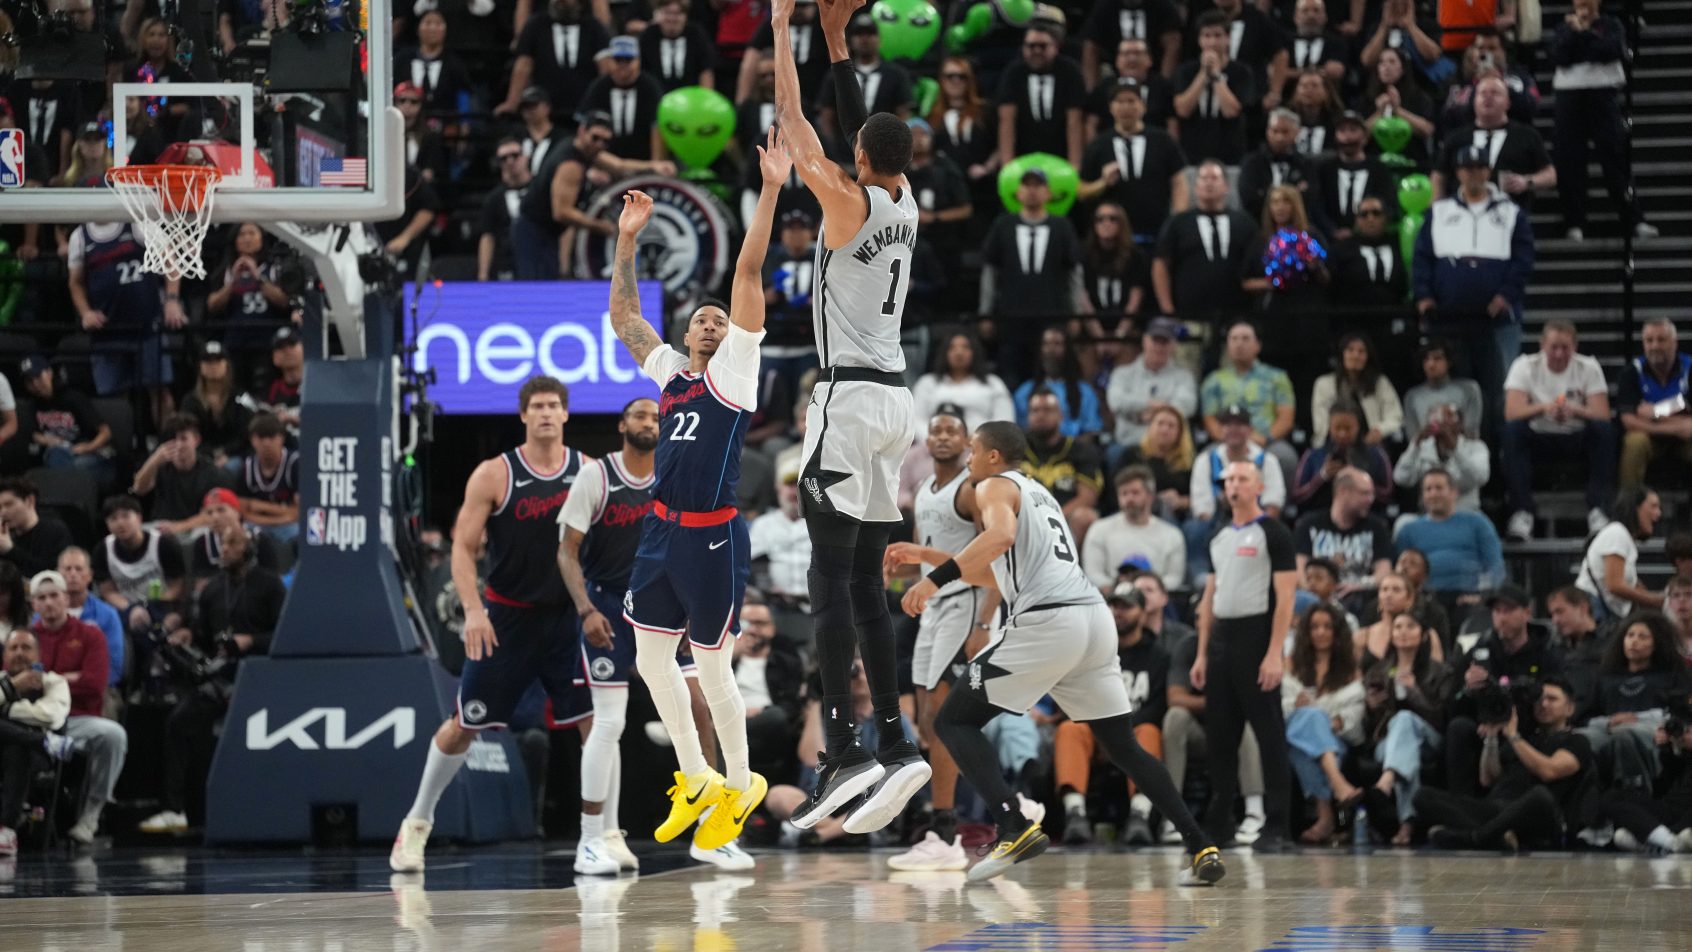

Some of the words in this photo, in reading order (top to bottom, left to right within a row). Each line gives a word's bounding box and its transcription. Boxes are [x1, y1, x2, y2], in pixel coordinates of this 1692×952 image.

[880, 256, 902, 317] 1
[670, 411, 701, 441] 22
[318, 436, 358, 471] GET
[317, 472, 358, 507] THE
[325, 507, 367, 551] App
[1047, 516, 1075, 563] 3
[246, 706, 416, 750] KIA
